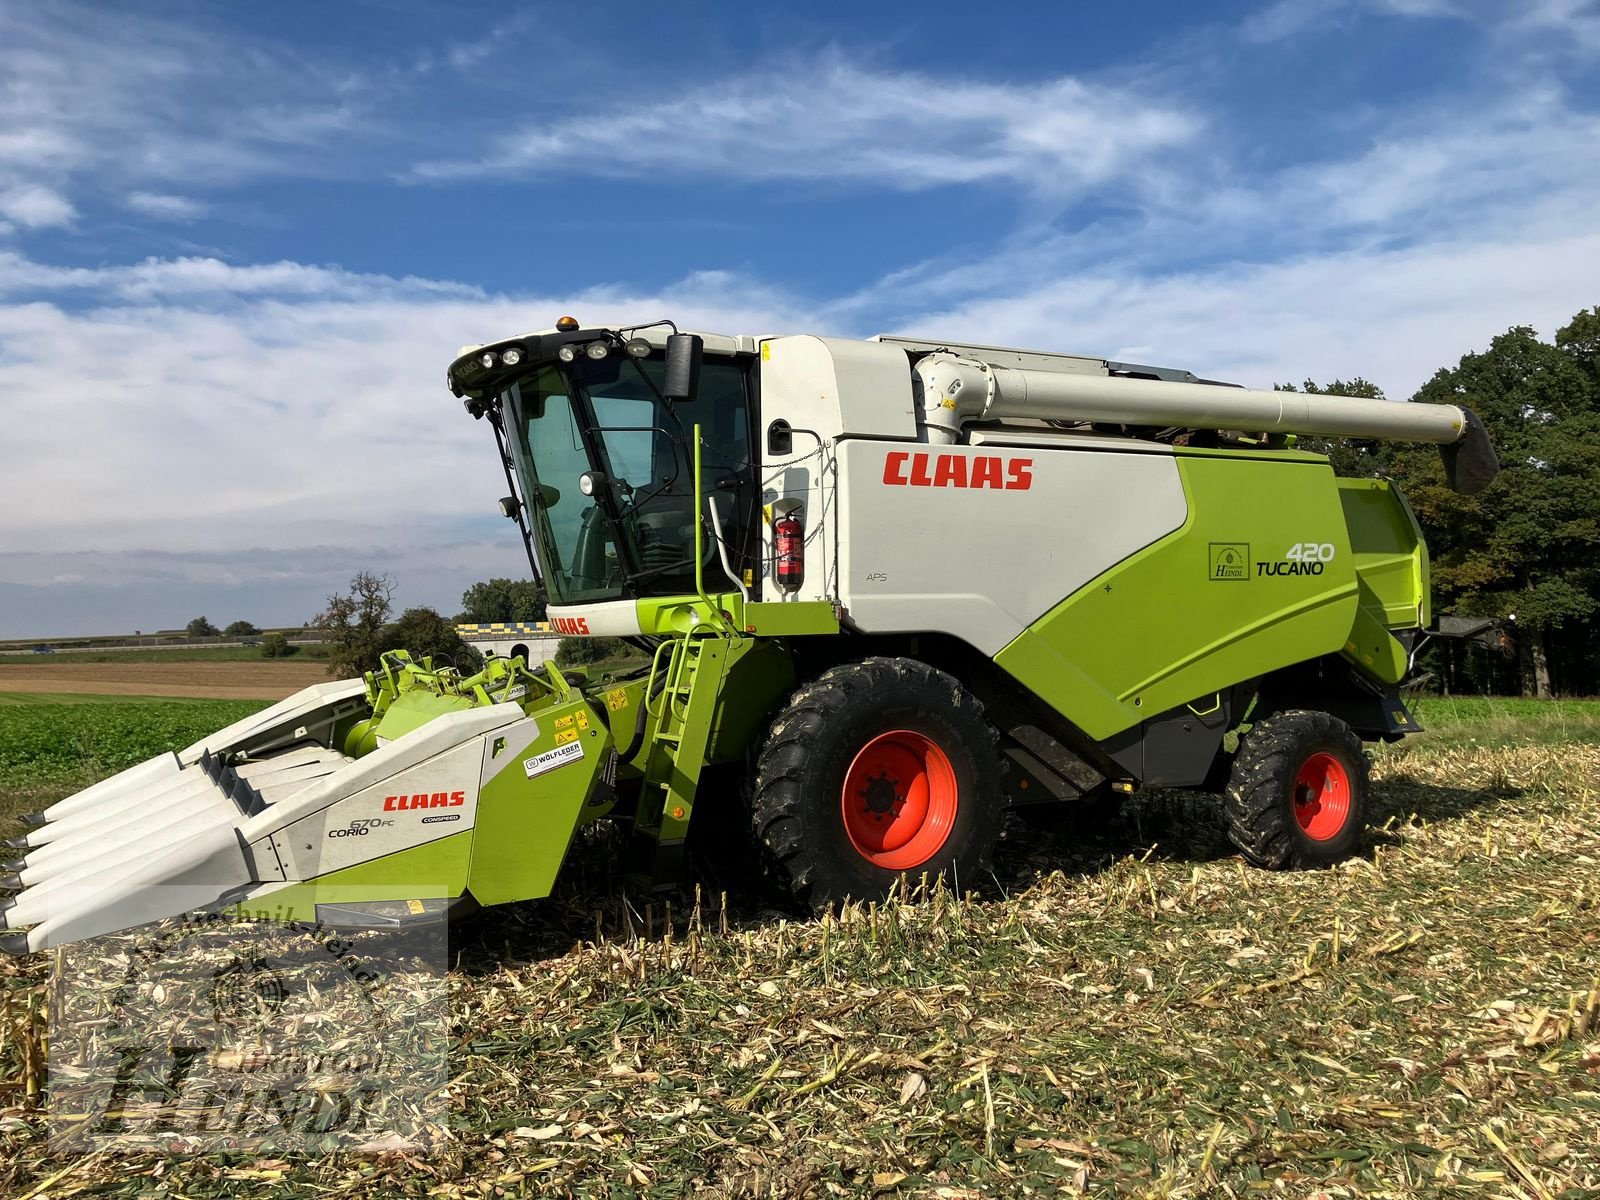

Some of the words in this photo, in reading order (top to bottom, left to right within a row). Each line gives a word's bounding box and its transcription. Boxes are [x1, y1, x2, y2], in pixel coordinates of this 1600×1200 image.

[883, 451, 1033, 490] CLAAS
[1286, 543, 1335, 562] 420
[1257, 562, 1324, 576] TUCANO
[865, 573, 888, 581] APS
[383, 791, 465, 811] CLAAS
[423, 815, 459, 823] CONSPEED
[328, 828, 369, 838] CORIO
